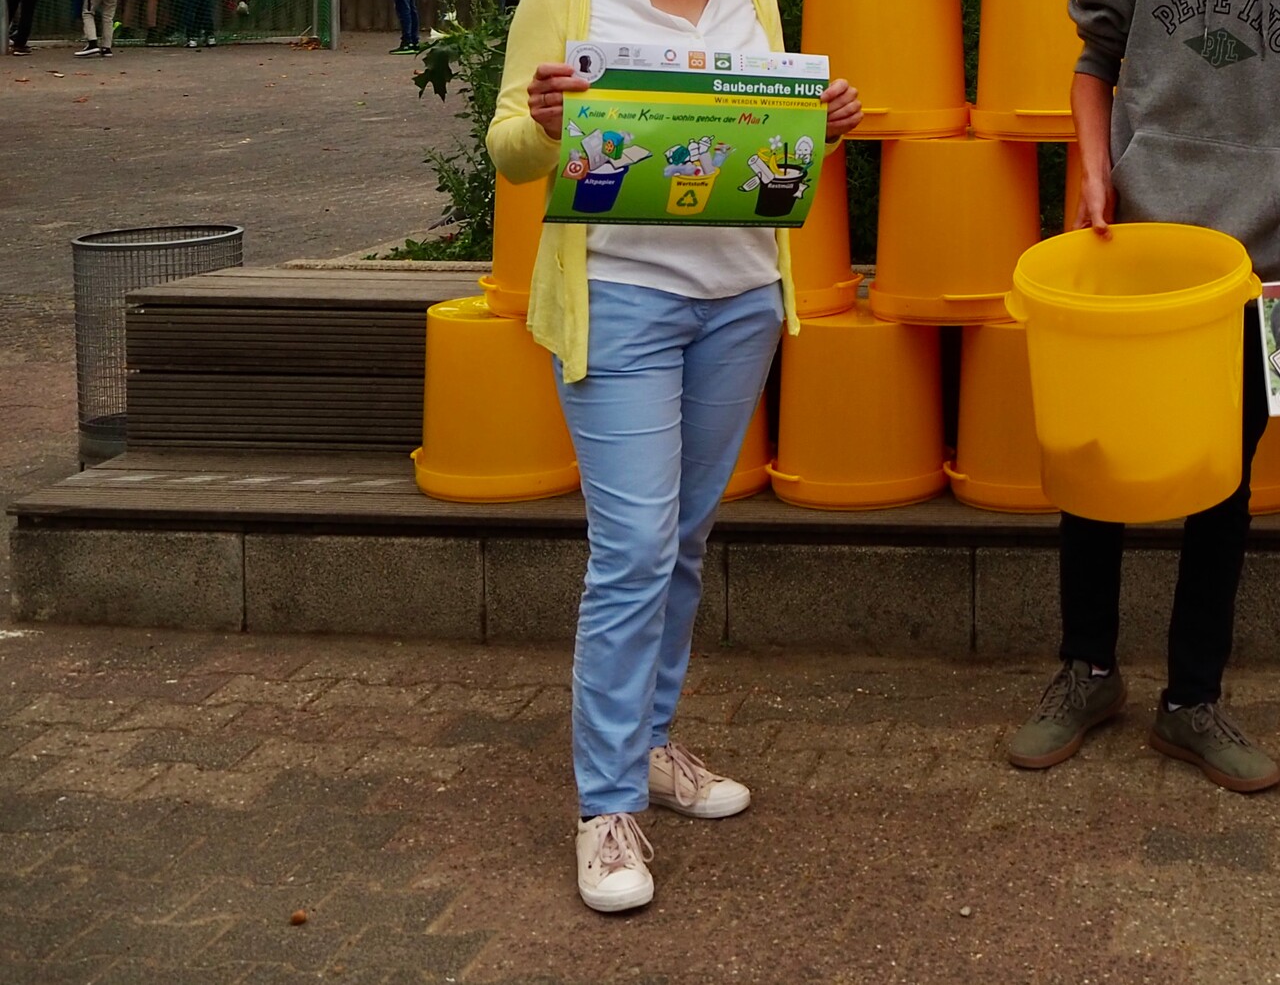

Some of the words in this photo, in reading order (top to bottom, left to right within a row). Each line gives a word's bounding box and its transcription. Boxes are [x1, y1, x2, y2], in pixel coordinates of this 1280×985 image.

[1201, 31, 1238, 65] PJL
[713, 79, 791, 95] Sauberhafte
[795, 83, 823, 96] HUS
[578, 105, 606, 118] Knille
[638, 108, 664, 121] Knüll
[695, 115, 721, 123] gehört
[738, 112, 760, 125] Müll
[584, 178, 616, 187] Altpapier
[676, 180, 709, 188] Wertstoffe
